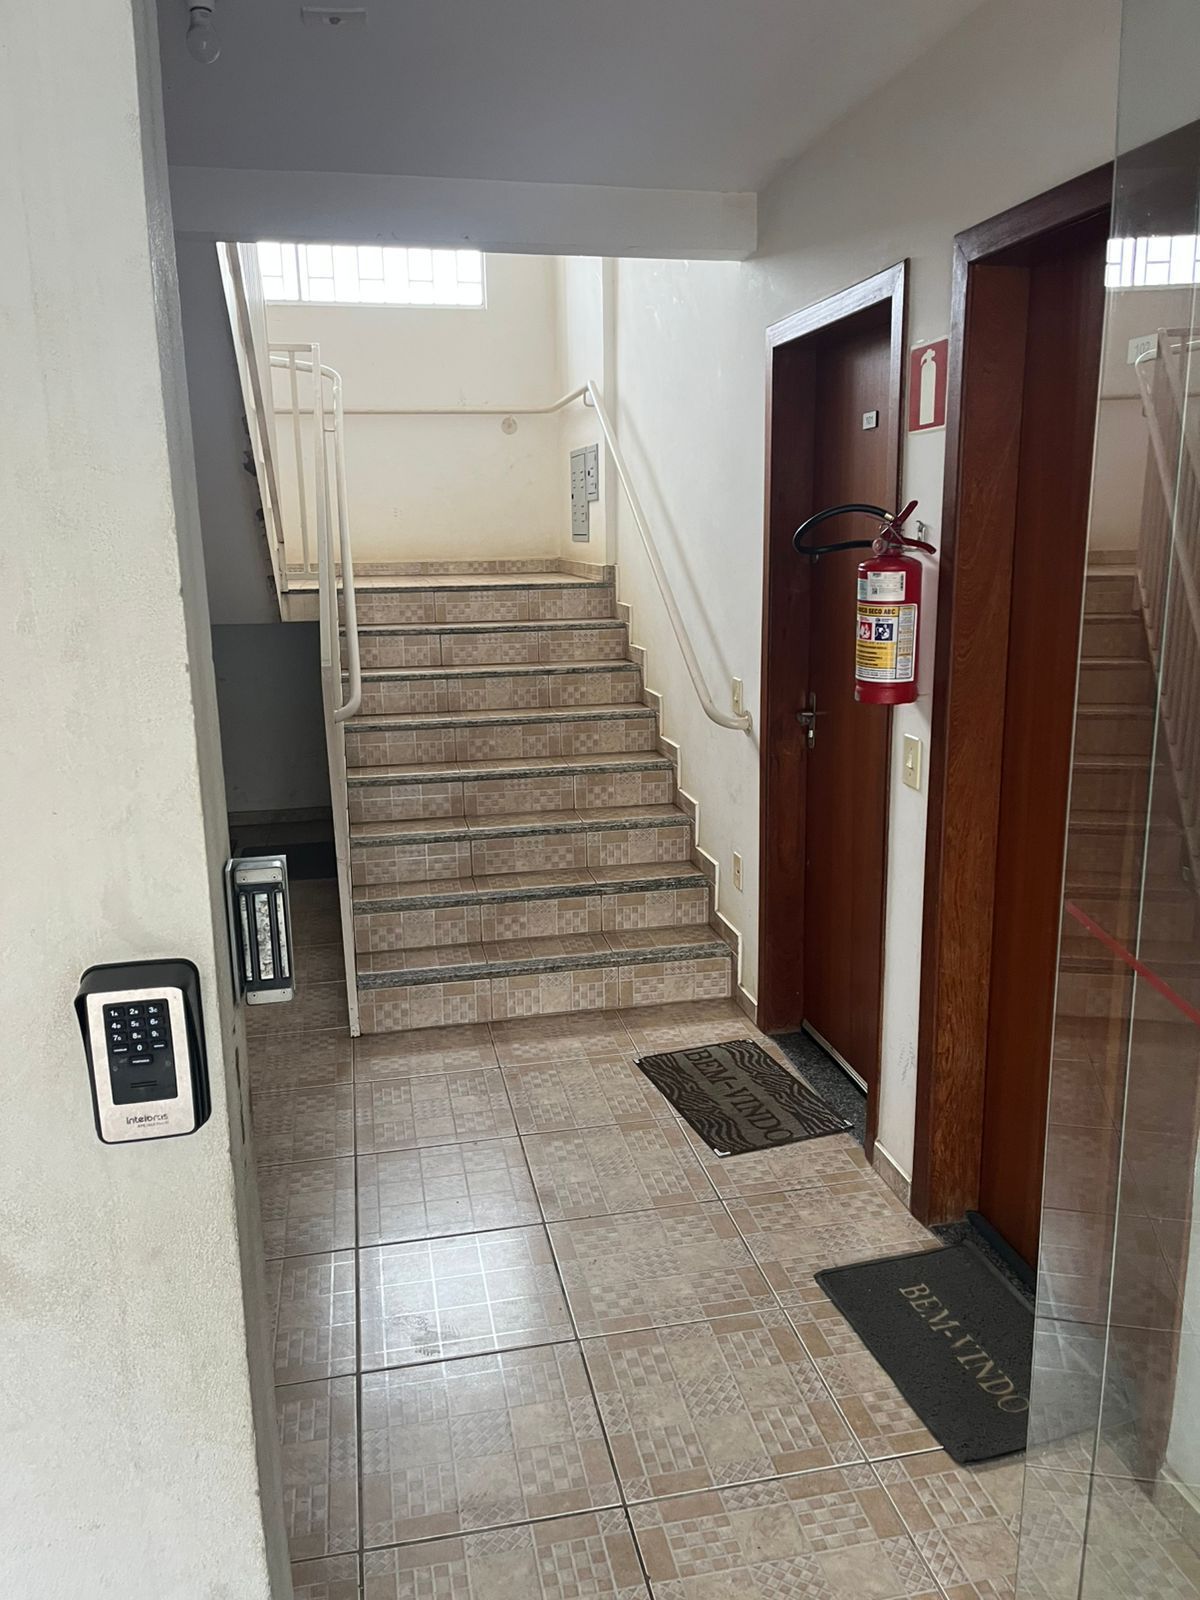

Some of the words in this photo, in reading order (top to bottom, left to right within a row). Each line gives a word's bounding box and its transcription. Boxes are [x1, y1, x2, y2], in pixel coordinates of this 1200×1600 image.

[869, 607, 883, 615] SECO
[136, 1044, 143, 1052] 0
[683, 1048, 794, 1142] BEM-VINDO
[899, 1282, 1029, 1413] BEM-VINDO
